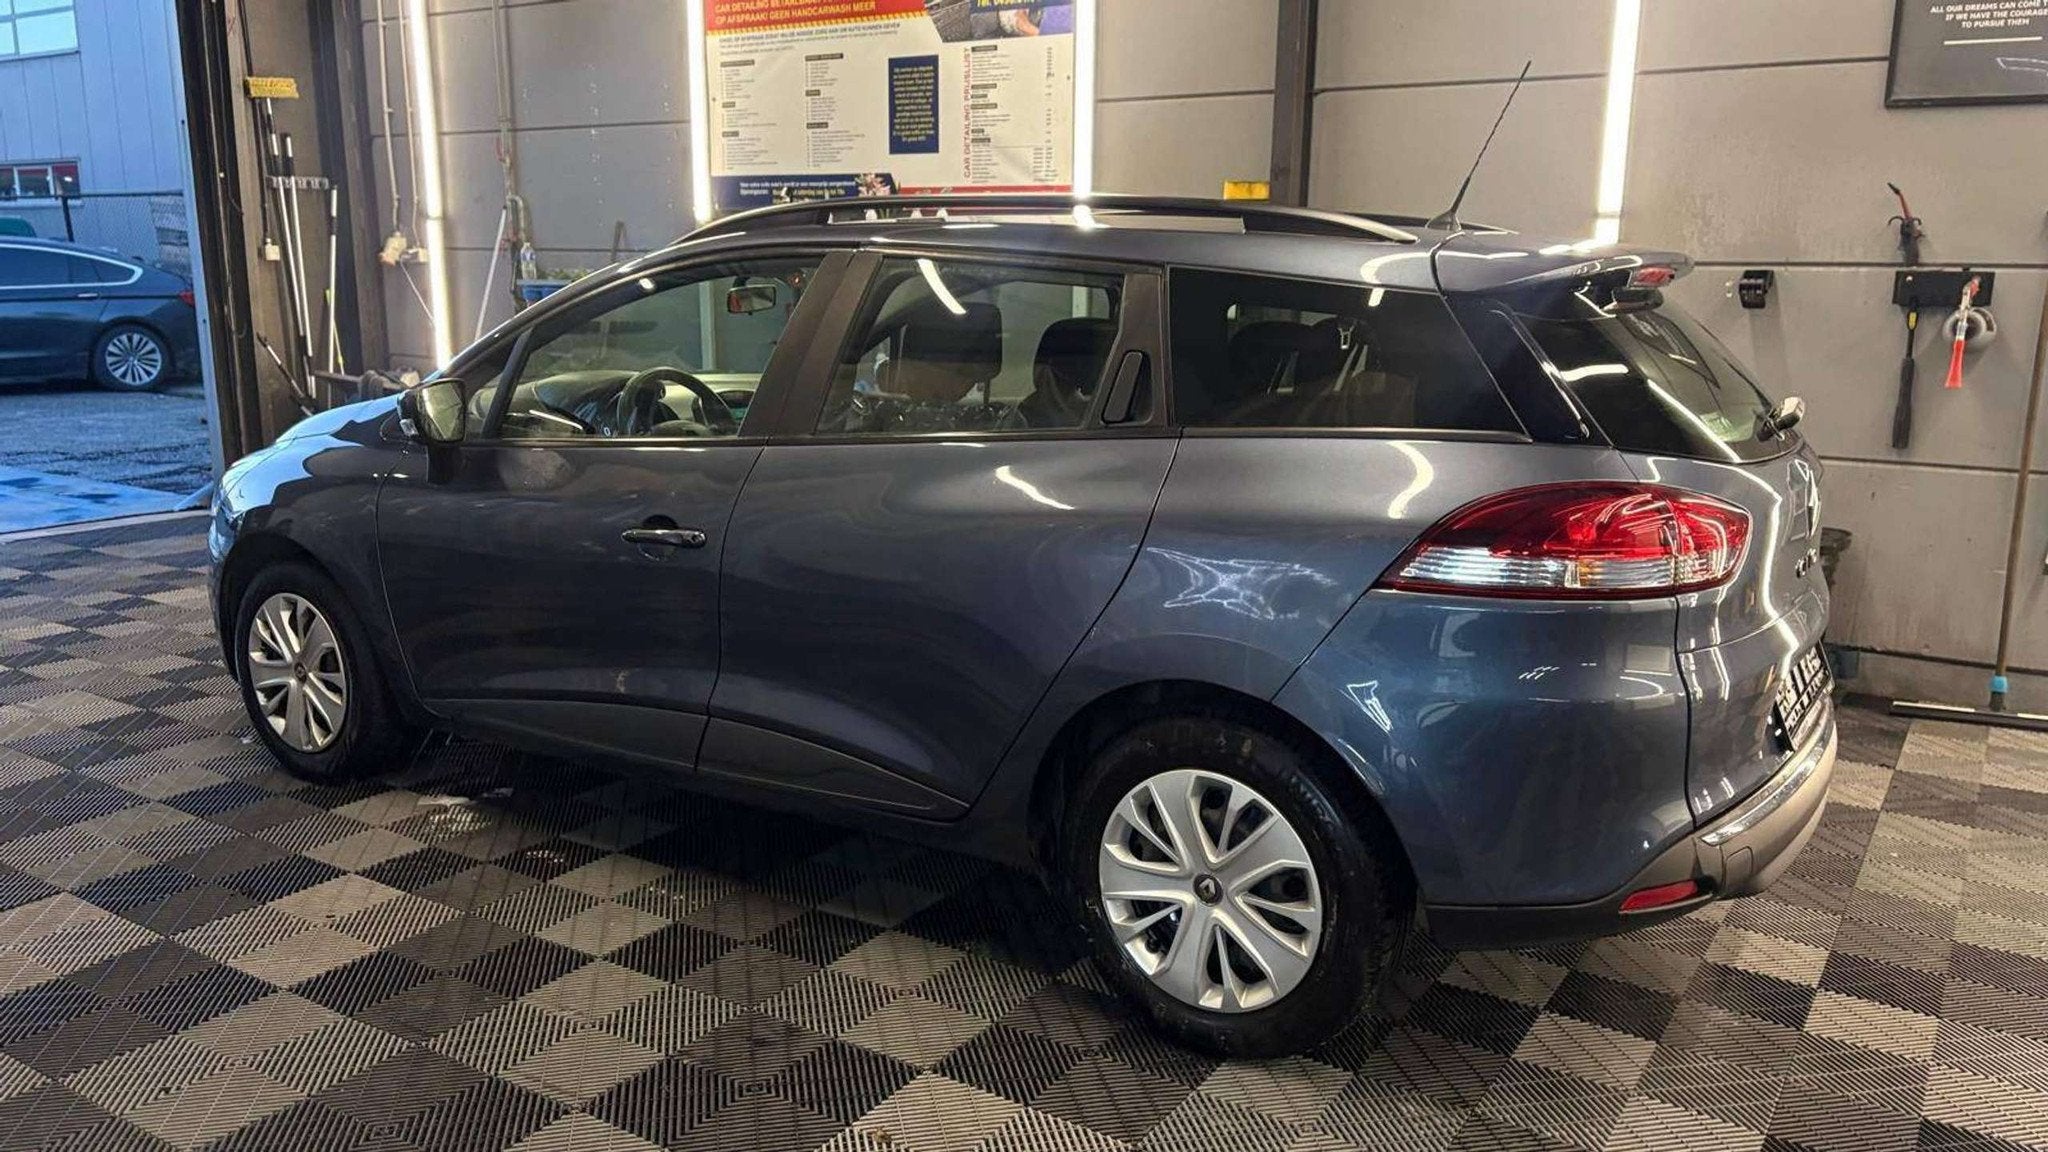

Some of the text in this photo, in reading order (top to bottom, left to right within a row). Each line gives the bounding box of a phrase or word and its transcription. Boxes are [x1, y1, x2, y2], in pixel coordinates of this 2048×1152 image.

[769, 9, 790, 19] GEEN
[852, 1, 876, 12] MEER
[1965, 3, 1998, 11] DREAMS
[2018, 0, 2040, 8] COME
[1993, 10, 2008, 18] THE
[2010, 8, 2048, 17] COURAGE
[1974, 20, 2005, 28] PURSUE
[2007, 18, 2030, 26] THEM
[963, 104, 971, 155] DETAILING
[963, 157, 971, 178] CAR
